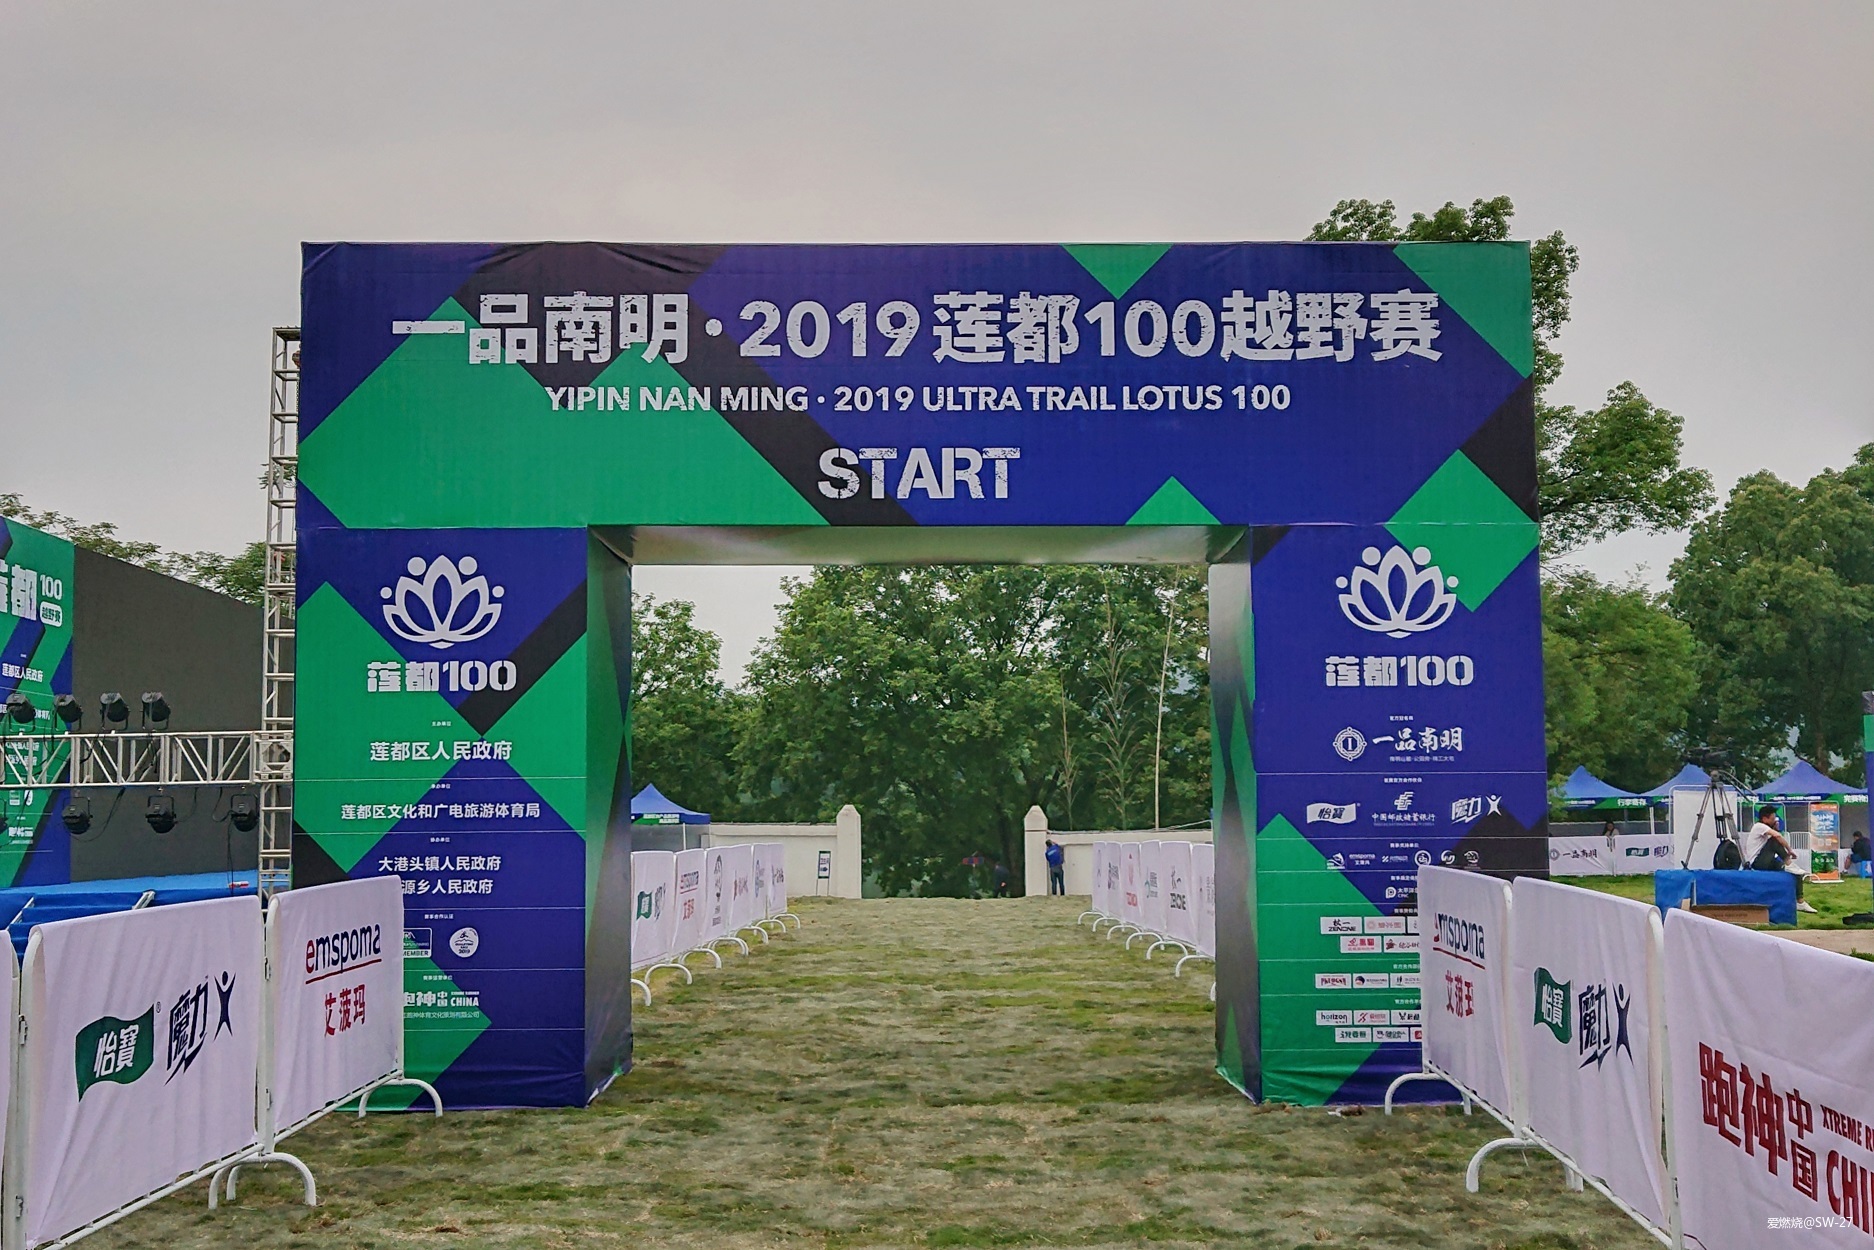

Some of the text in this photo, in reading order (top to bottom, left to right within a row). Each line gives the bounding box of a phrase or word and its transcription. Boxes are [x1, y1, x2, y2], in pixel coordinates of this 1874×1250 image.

[545, 386, 630, 411] YIPIN
[639, 386, 711, 411] NAN
[720, 386, 808, 411] MING
[833, 386, 915, 411] 2019
[922, 386, 1023, 411] ULTRA
[1026, 386, 1116, 411] TRAIL
[1122, 385, 1222, 411] LOTUS
[1231, 384, 1291, 411] 100
[818, 447, 1021, 499] START
[39, 574, 63, 600] 100
[369, 741, 513, 762] 莲都区人民政府
[1372, 726, 1463, 754] 一品南明
[340, 803, 541, 820] 莲都区文化和广电旅游体育局
[378, 856, 502, 872] 大港头镇人民政府
[401, 879, 494, 895] 源乡人民政府
[305, 924, 381, 974] emspoma
[324, 983, 366, 1037] 艾菠玛
[450, 996, 480, 1007] CHINA
[93, 1024, 140, 1078] 怡寶
[1820, 1104, 1874, 1152] XTREME R
